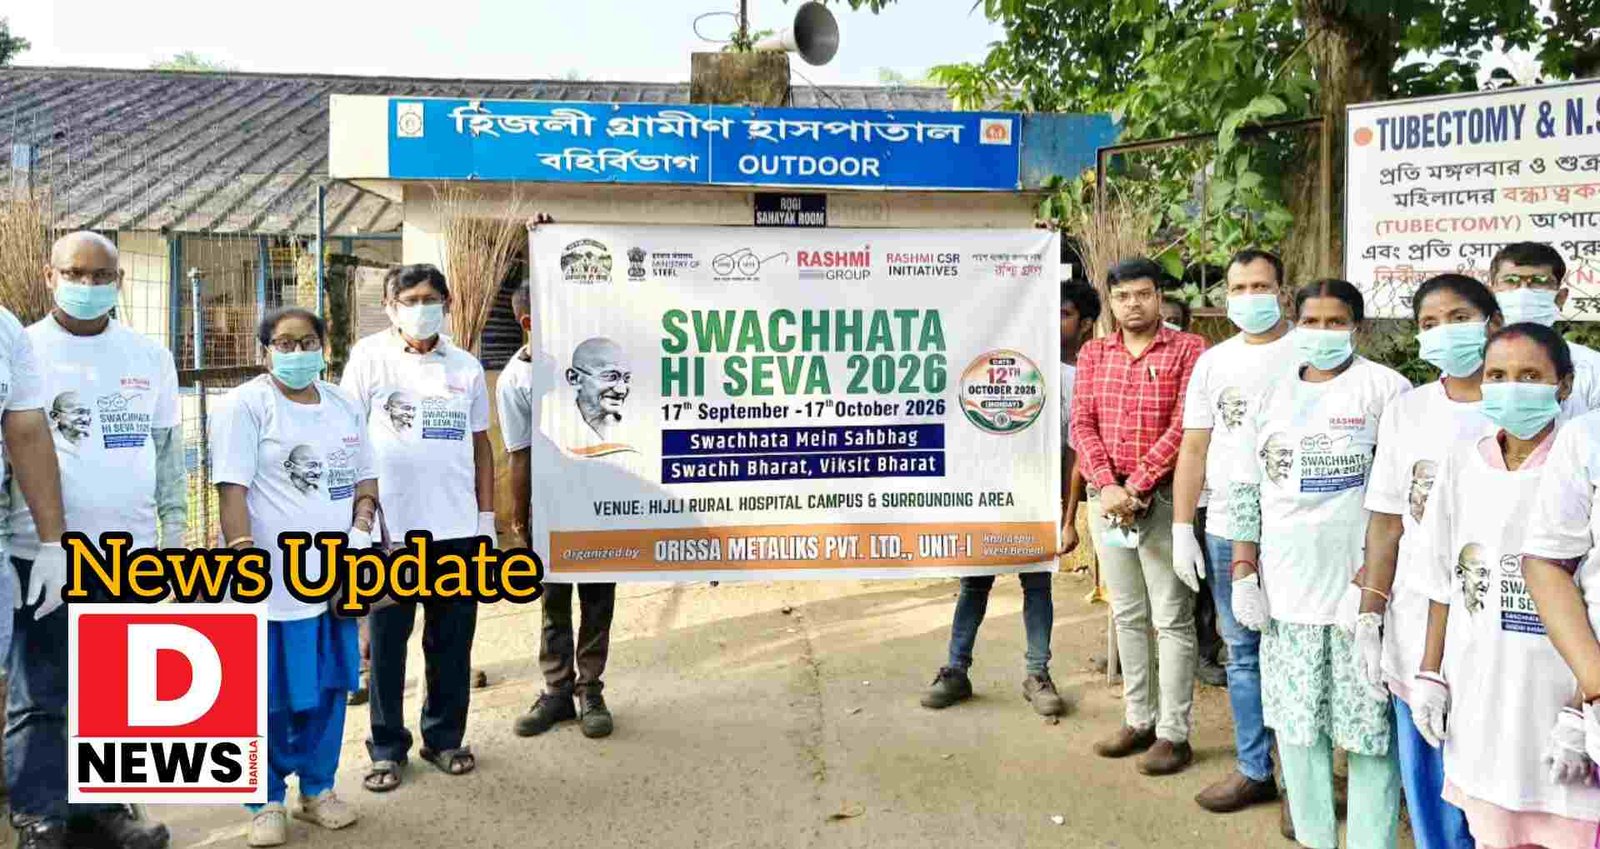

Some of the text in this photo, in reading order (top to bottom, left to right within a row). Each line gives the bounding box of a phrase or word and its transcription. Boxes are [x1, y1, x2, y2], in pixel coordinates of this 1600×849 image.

[448, 105, 966, 143] হিজলী গ্রামীণ হাসপাতাল
[1376, 103, 1526, 151] TUBECTOMY
[1536, 100, 1556, 139] &
[536, 147, 700, 174] বহির্বিভাগ
[738, 155, 880, 177] OUTDOOR
[1379, 162, 1422, 186] প্রতি
[1427, 159, 1522, 183] মঙ্গলবার
[1529, 157, 1546, 174] ও
[780, 197, 801, 211] ROGI
[1393, 187, 1497, 208] মহিলাদের
[756, 211, 796, 225] SAHAYAK
[798, 211, 825, 225] ROOM
[1375, 213, 1521, 237] (TUBECTOMY)
[886, 252, 960, 263] RASHMI CSR
[1361, 246, 1400, 261] এবং
[1408, 239, 1453, 262] প্রতি
[652, 268, 678, 276] STEEL
[826, 270, 871, 280] GROUP
[888, 265, 959, 276] INITIATIVES
[661, 308, 947, 353] SWACHHATA
[661, 353, 947, 397] HI SEVA 2026
[968, 385, 1036, 395] OCTOBER 2026
[698, 401, 789, 424] September
[836, 399, 900, 418] October
[905, 399, 946, 416] 2026
[690, 429, 919, 450] Swachhata Mein Sahbhag
[671, 455, 937, 479] Swachh Bharat, Viksit Bharat
[593, 492, 1015, 516] VENUE: HIJLI RURAL HOSPITAL CAMPUS & SURROUNDING AREA
[655, 537, 722, 562] ORISSA
[728, 535, 820, 561] METALIKS
[825, 535, 865, 560] PVT.
[918, 533, 972, 559] UNIT-I
[1501, 596, 1534, 611] HI SE
